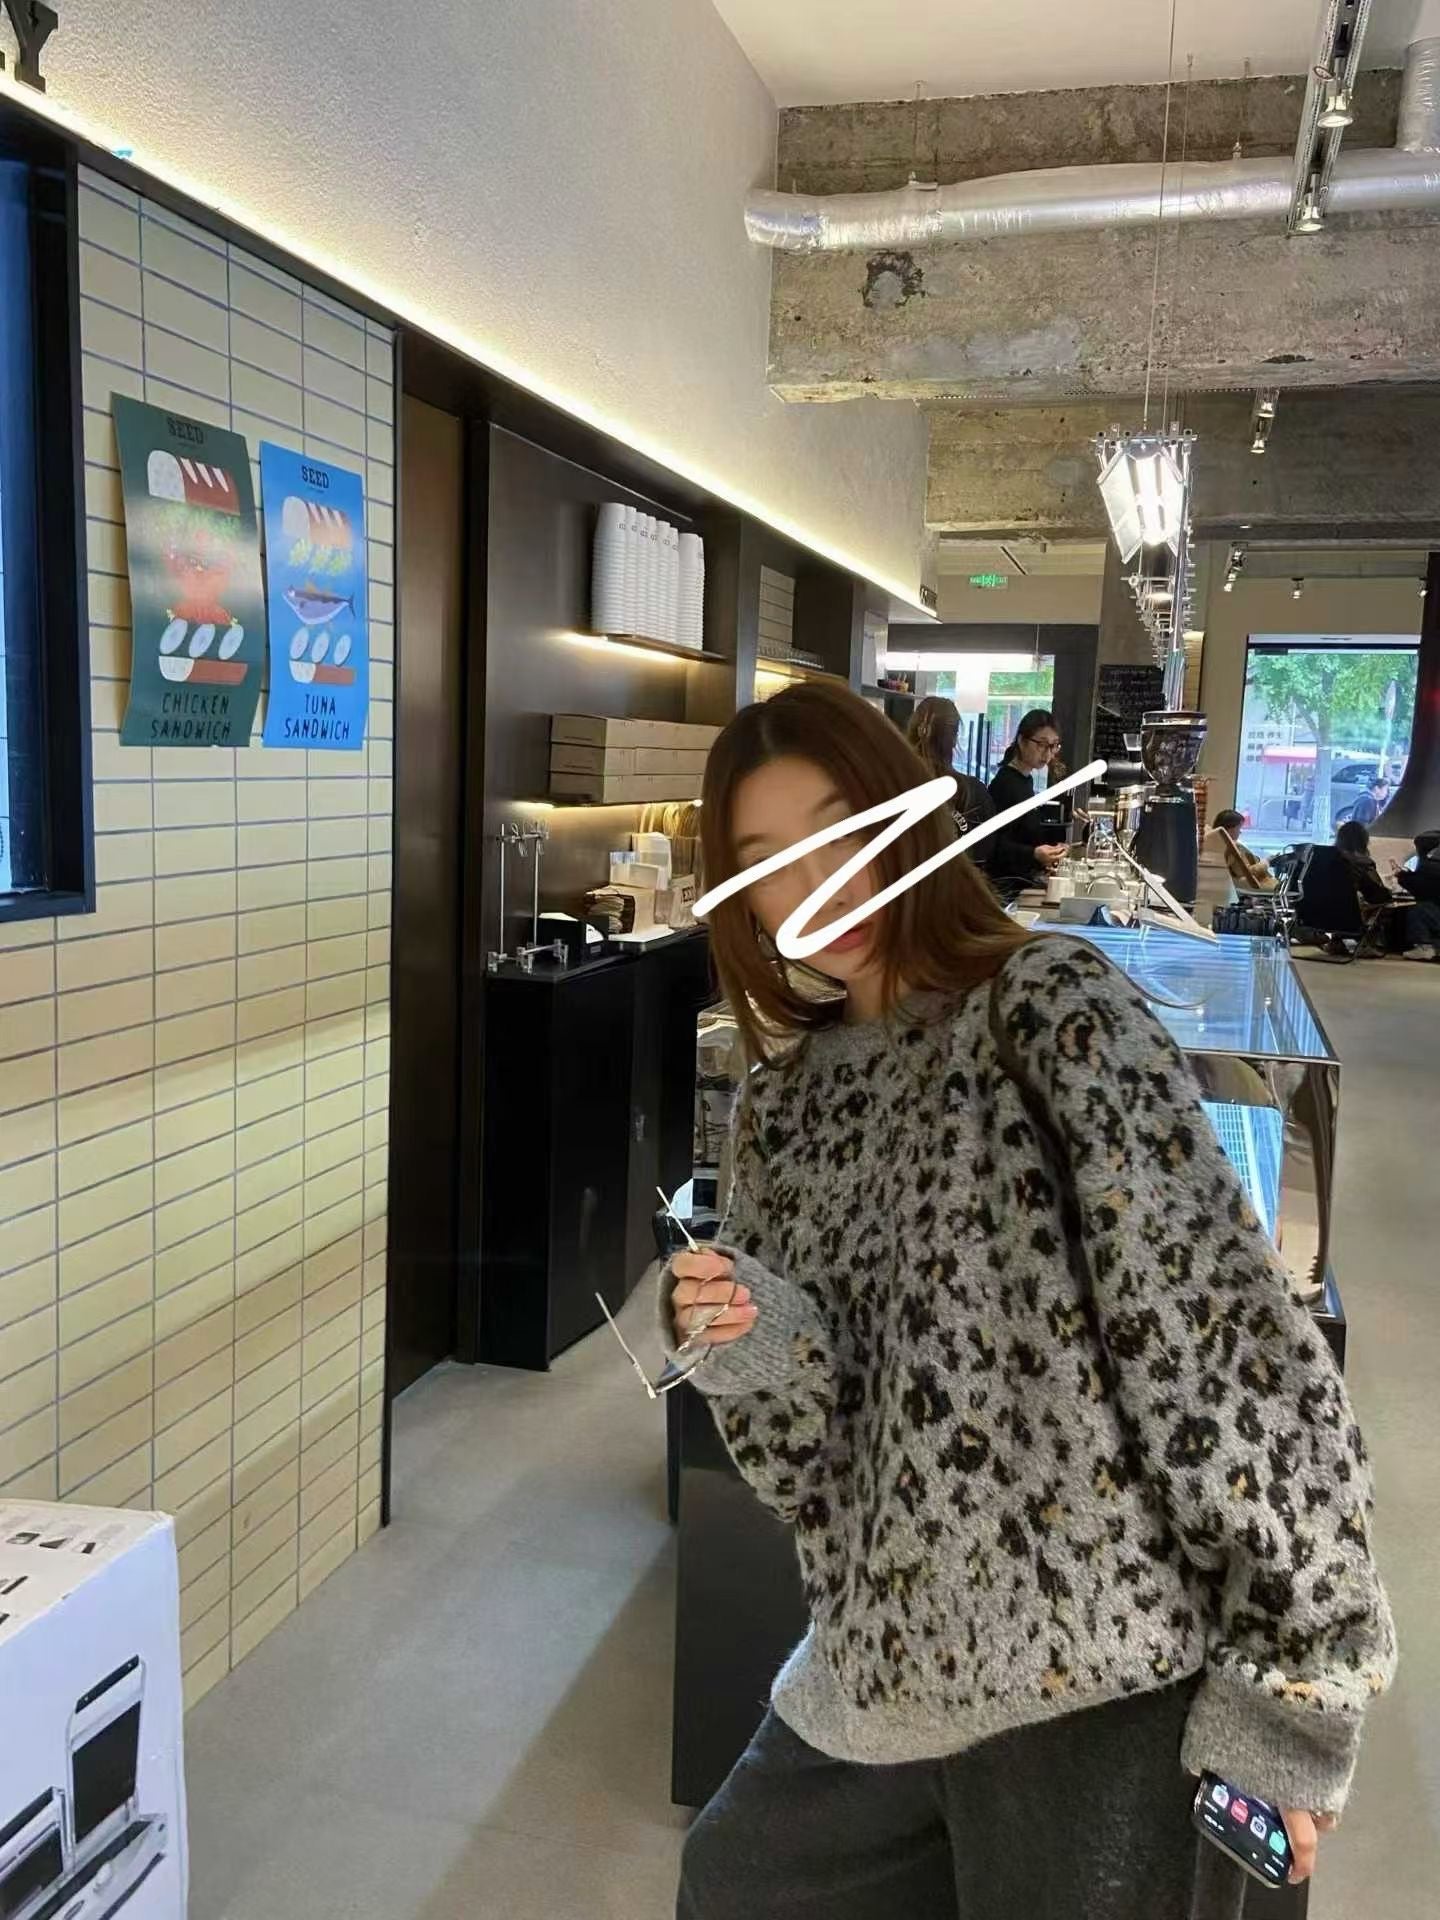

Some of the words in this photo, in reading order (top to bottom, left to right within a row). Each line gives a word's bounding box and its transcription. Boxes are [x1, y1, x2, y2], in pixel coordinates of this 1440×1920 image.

[166, 416, 204, 445] SEED
[301, 464, 329, 488] SEED
[162, 692, 229, 714] CHICKEN
[305, 693, 335, 715] TUNA
[150, 720, 231, 740] SANDWICH
[284, 717, 349, 740] SANDWICH
